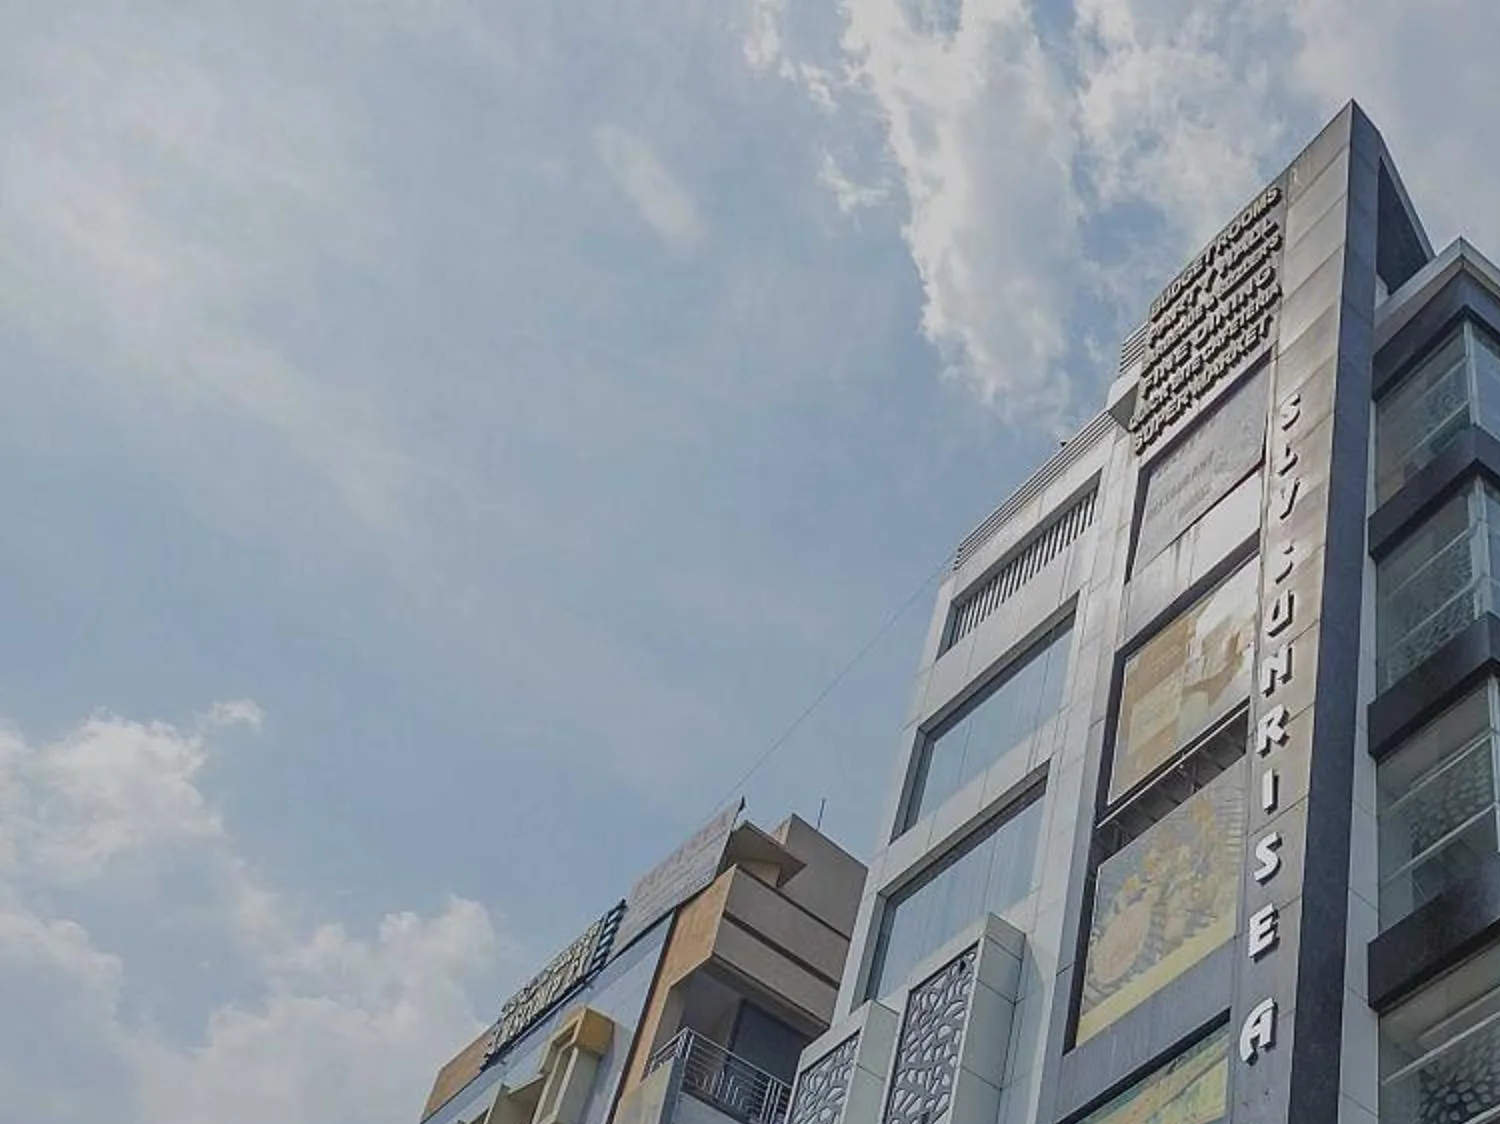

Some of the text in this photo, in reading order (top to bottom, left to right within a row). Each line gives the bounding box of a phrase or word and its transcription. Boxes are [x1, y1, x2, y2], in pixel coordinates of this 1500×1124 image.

[1151, 245, 1216, 321] BUDGET
[1217, 186, 1282, 255] ROOMS
[1134, 314, 1274, 456] SUPER MARKET
[1144, 340, 1193, 400] FINE
[1196, 267, 1277, 349] DINING
[1250, 540, 1297, 962] SUNRISE
